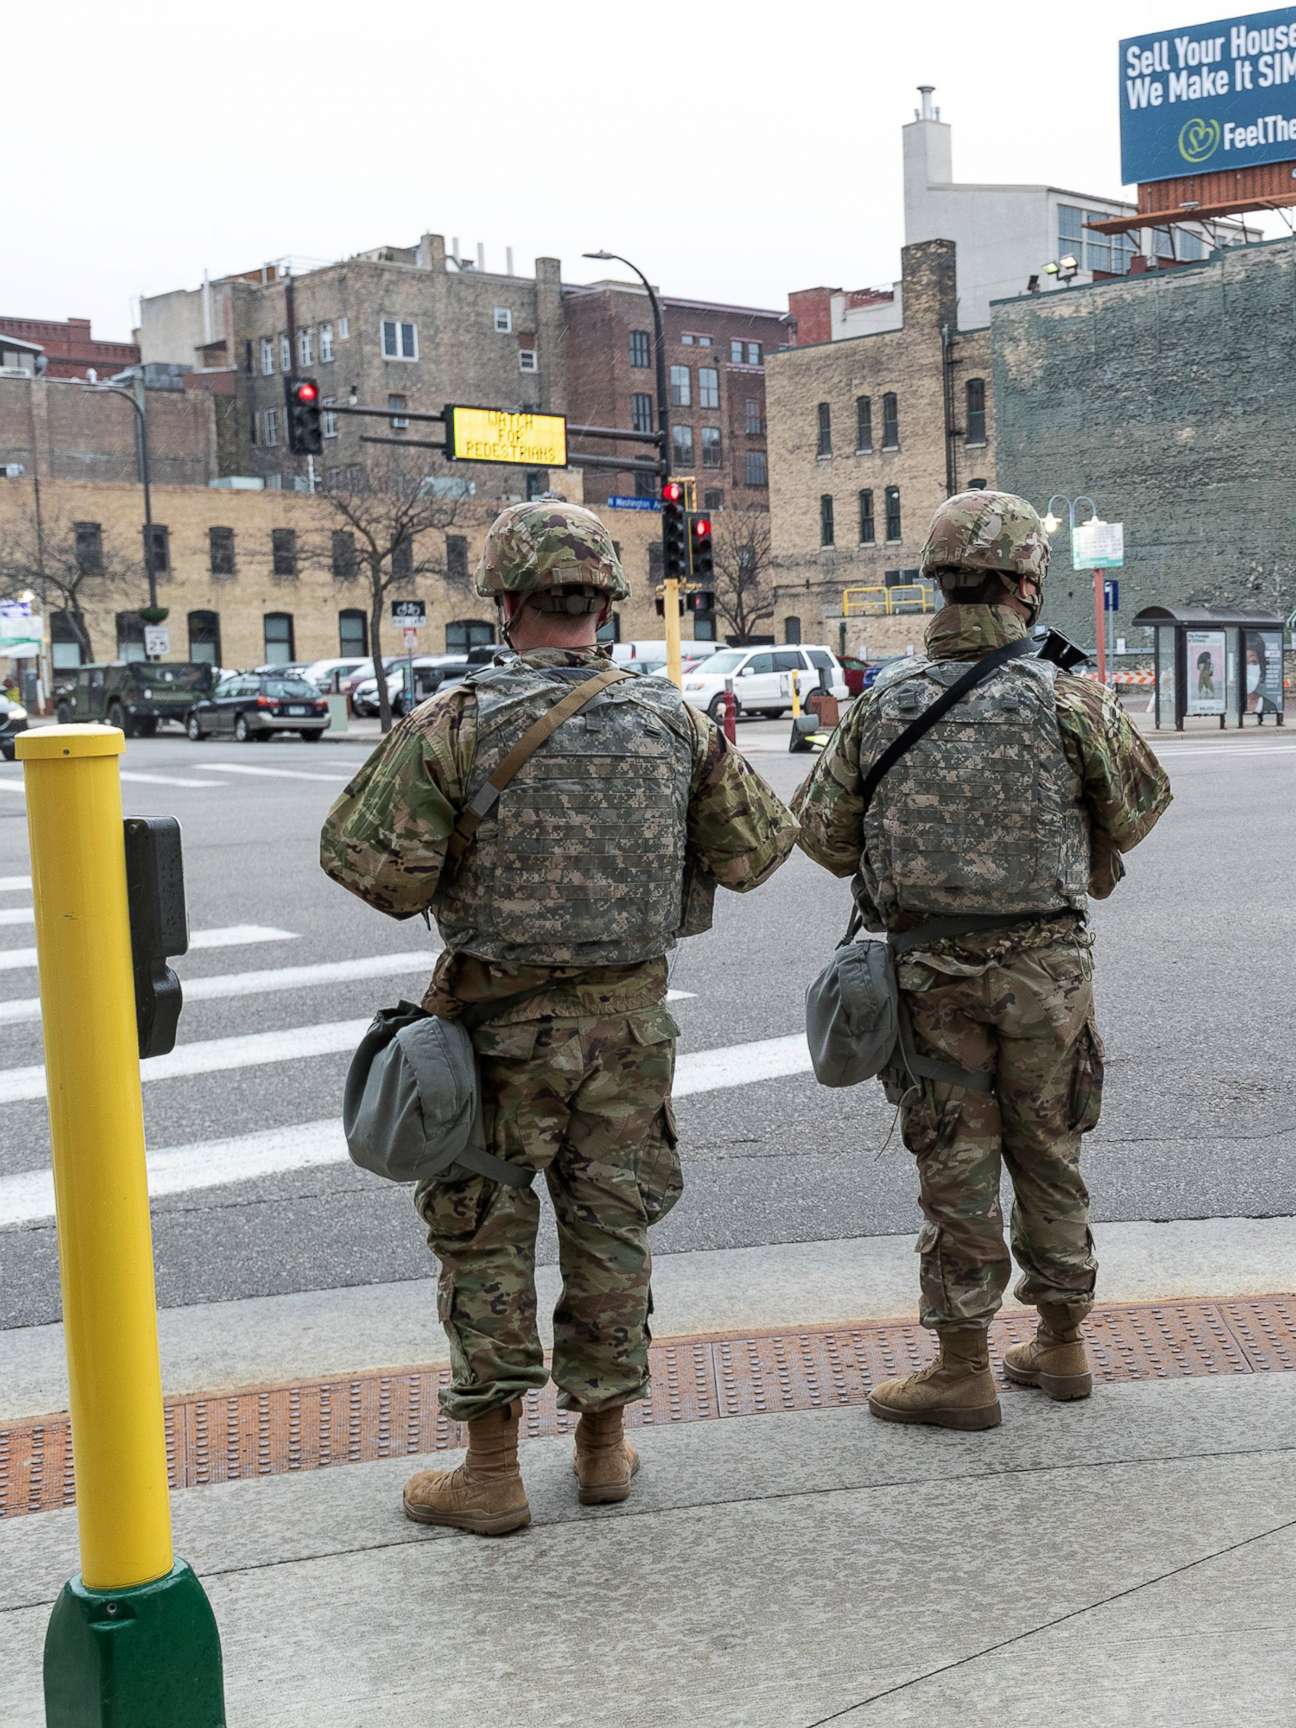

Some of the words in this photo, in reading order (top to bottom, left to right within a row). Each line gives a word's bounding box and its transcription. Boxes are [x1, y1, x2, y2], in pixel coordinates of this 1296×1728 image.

[1127, 40, 1171, 77] Sell
[1175, 36, 1226, 69] Your
[1126, 77, 1164, 110] We
[1168, 65, 1229, 103] Make
[1235, 59, 1254, 92] It
[488, 410, 534, 430] WATCH
[498, 428, 524, 444] FOR
[466, 441, 557, 463] PEDESTRIANS
[150, 640, 168, 652] 25
